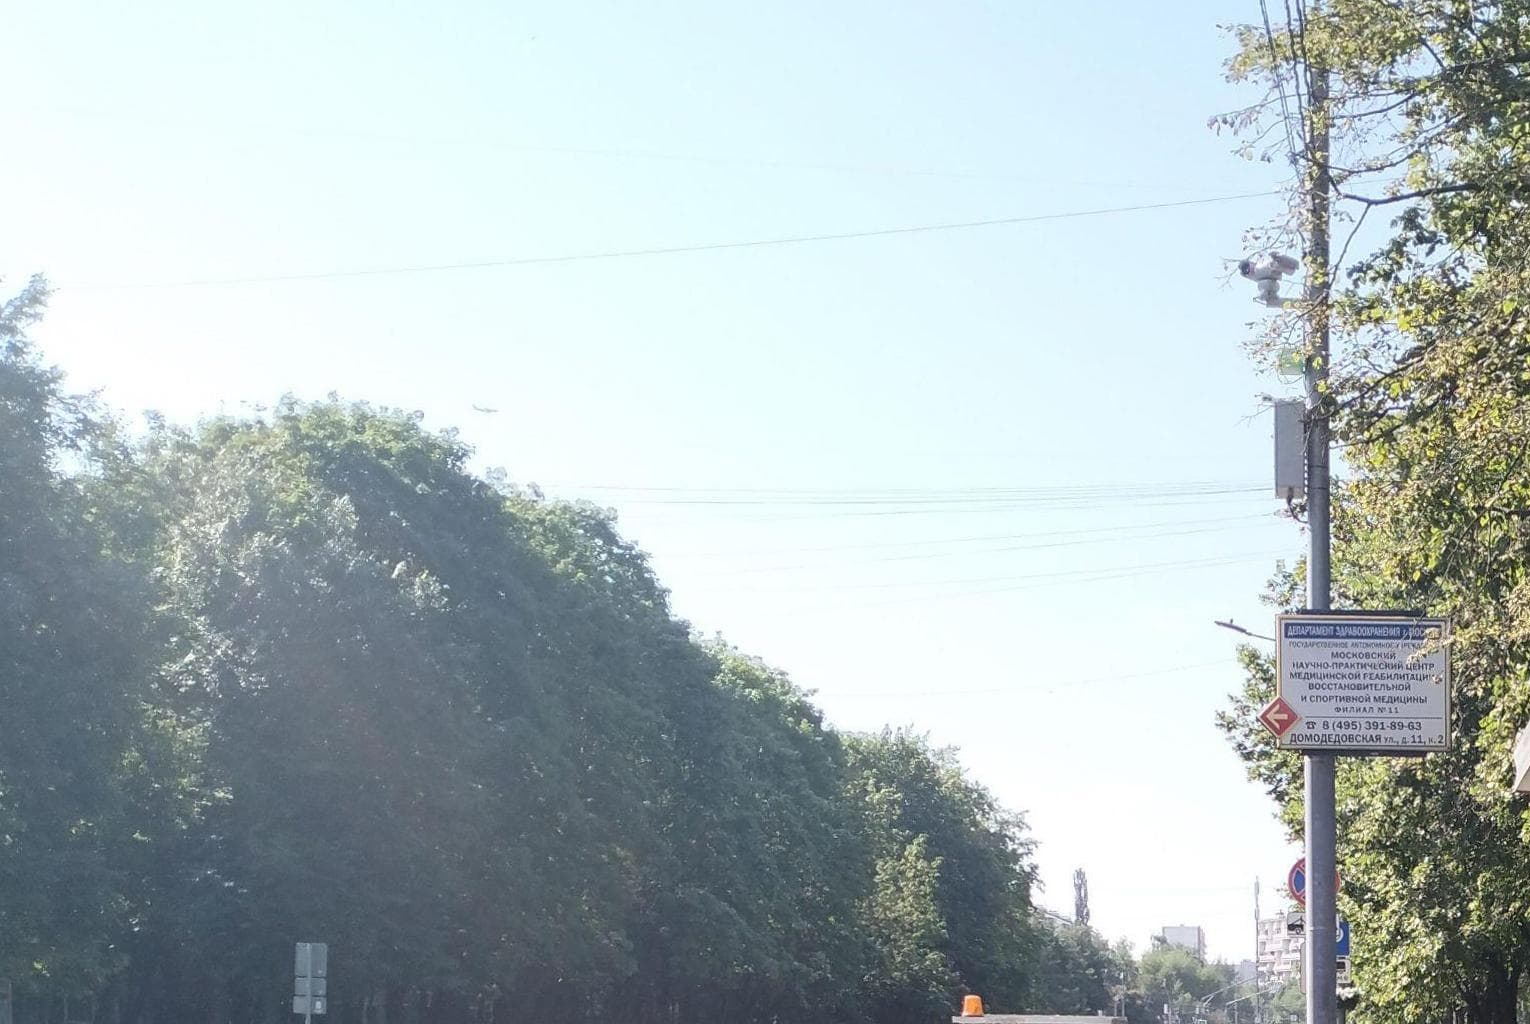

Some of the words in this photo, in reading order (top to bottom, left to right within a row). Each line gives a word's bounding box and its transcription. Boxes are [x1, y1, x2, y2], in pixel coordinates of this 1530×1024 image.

[1287, 626, 1334, 636] ДЕПАРТАМЕНТ
[1331, 651, 1397, 660] МОСКОВСКИЙ
[1292, 661, 1403, 670] НАУЧНО-ПРАКТИЧЕСКИЙ
[1405, 662, 1435, 672] ЦЕНТР
[1289, 671, 1360, 681] МЕДИЦИНСКОЙ
[1308, 682, 1411, 692] ВОССТАНОВИТЕЛЬНОЙ
[1300, 695, 1307, 703] И
[1309, 694, 1371, 704] СПОРТИВНОЙ
[1373, 695, 1428, 705] МЕДИЦИНЫ
[1334, 706, 1374, 714] ФИЛИАЛ
[1322, 720, 1330, 730] 8
[1332, 720, 1362, 731] (495)
[1364, 721, 1422, 731] 391-89-63
[1290, 733, 1382, 745] ДОМОДЕДОВСКАЯ
